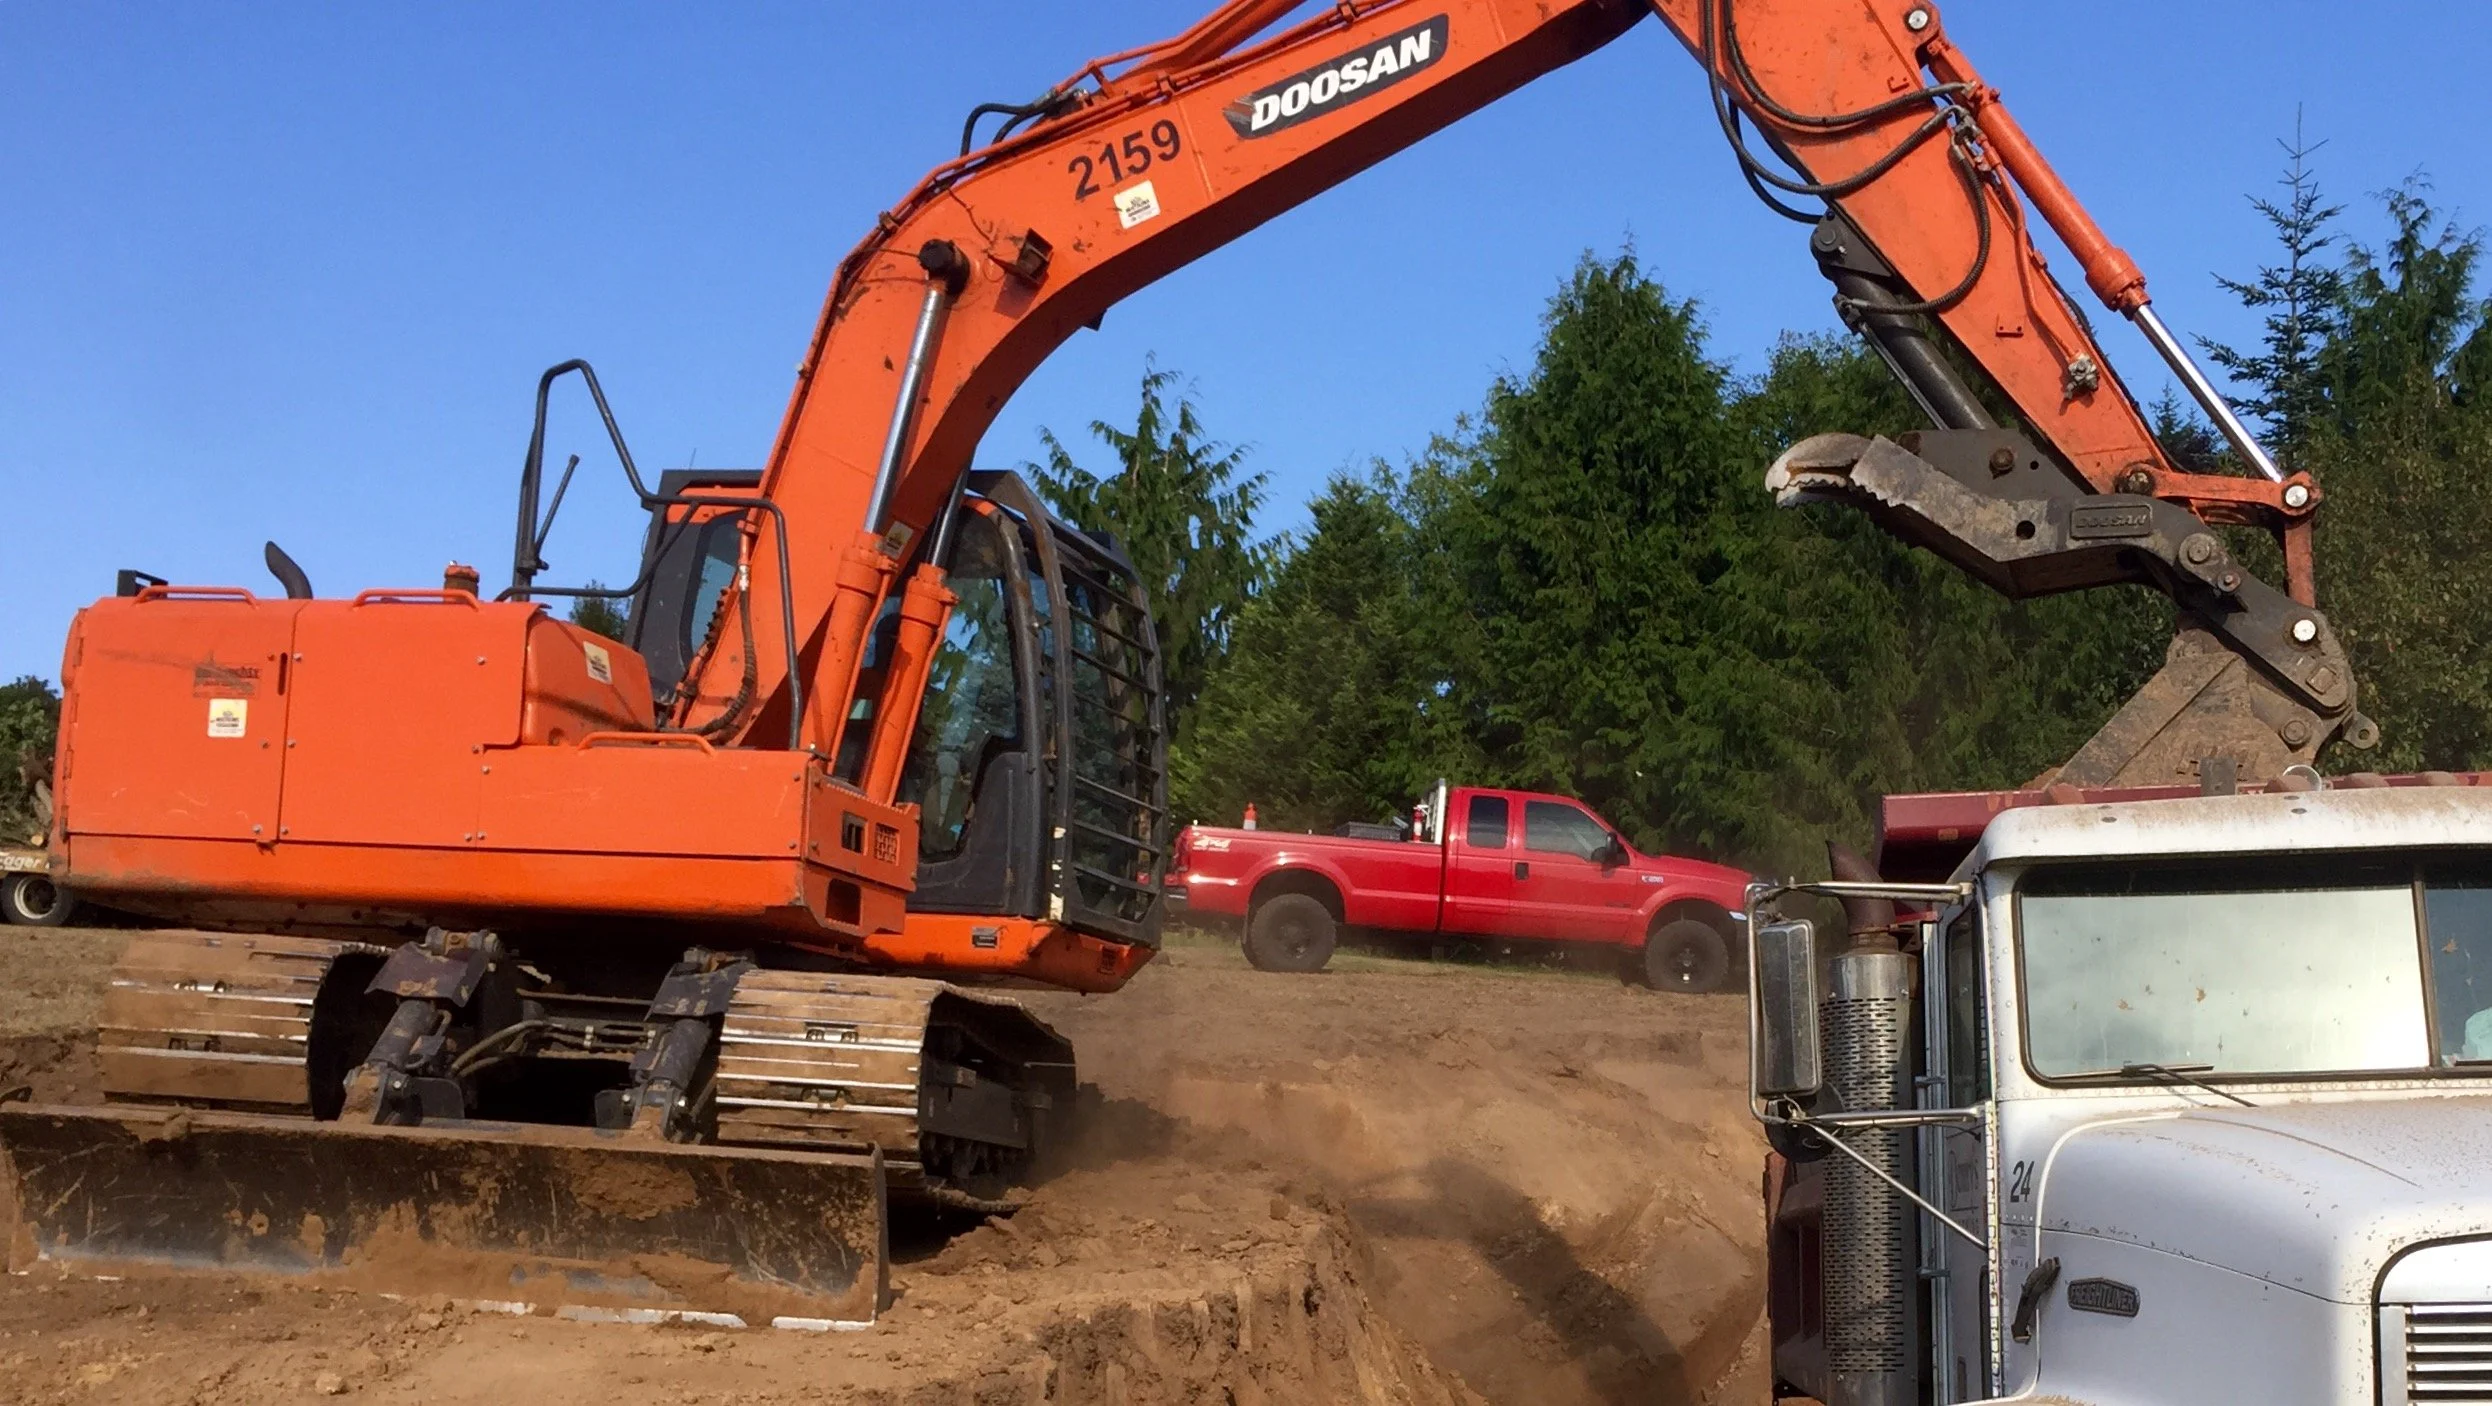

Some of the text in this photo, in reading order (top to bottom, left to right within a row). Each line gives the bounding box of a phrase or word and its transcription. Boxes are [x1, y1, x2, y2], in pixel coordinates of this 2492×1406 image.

[1251, 28, 1431, 131] DOOSAN
[1068, 119, 1180, 201] 2159
[2075, 514, 2148, 529] DOOSAN
[2010, 1161, 2035, 1202] 24
